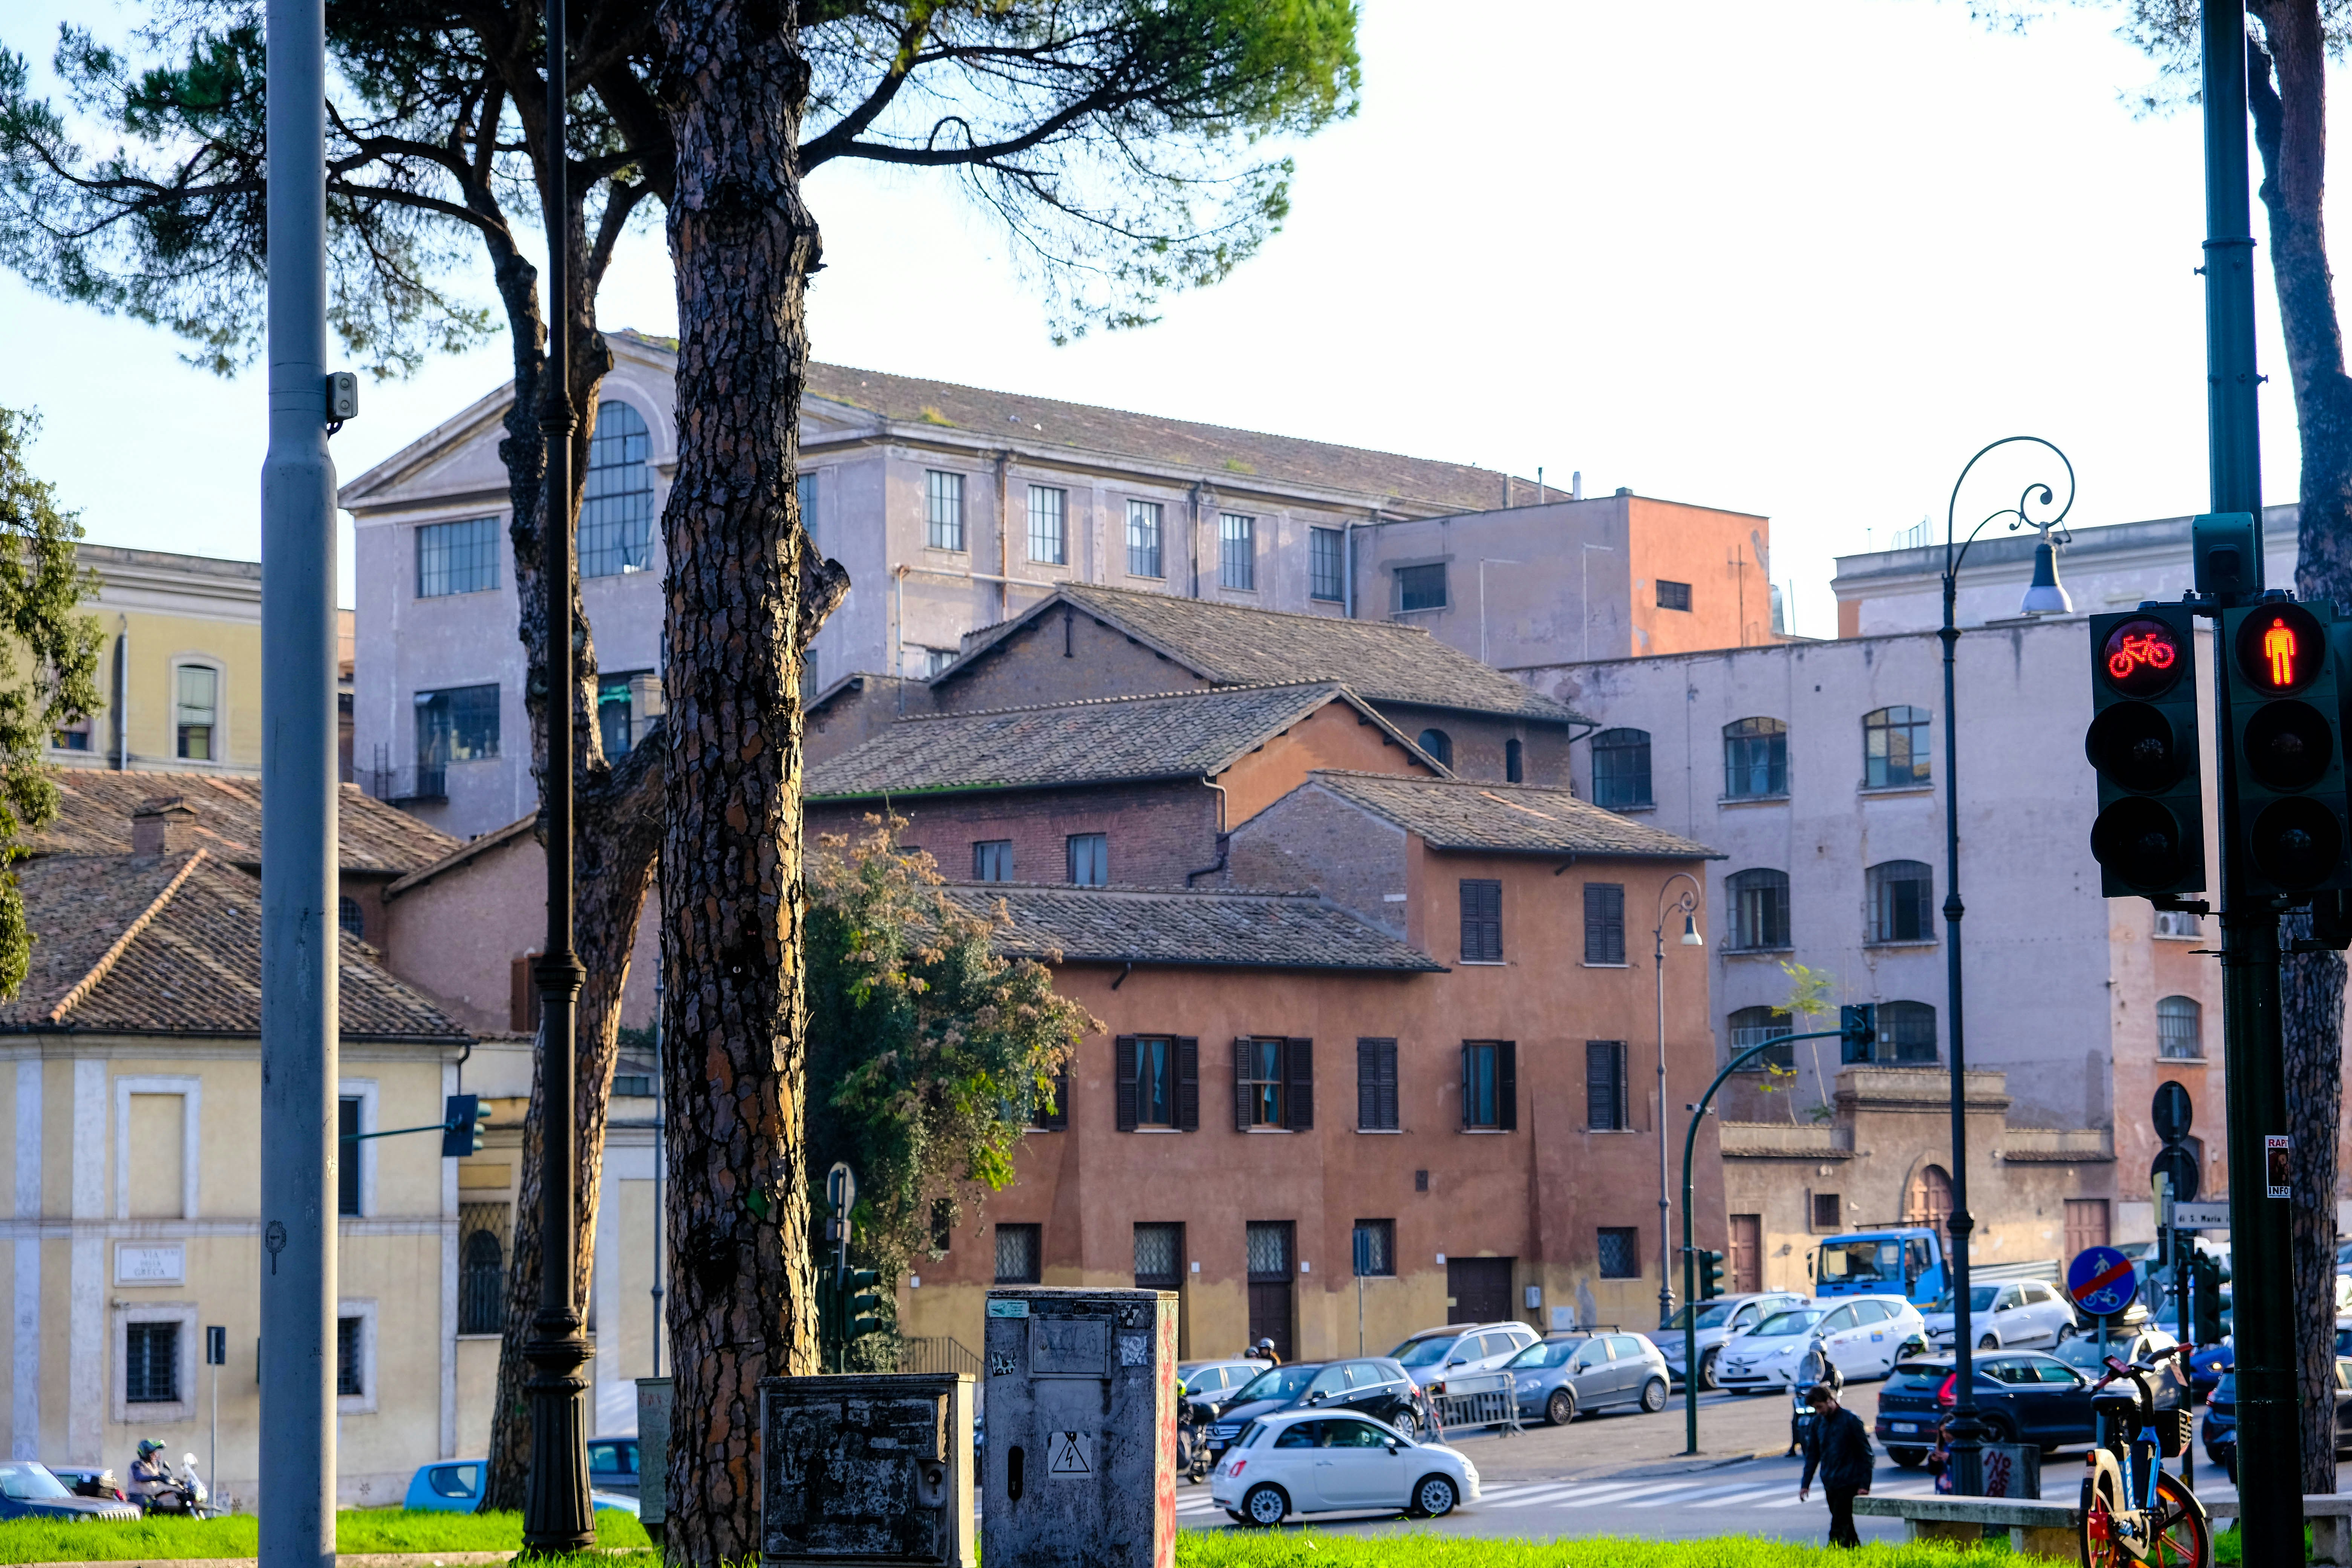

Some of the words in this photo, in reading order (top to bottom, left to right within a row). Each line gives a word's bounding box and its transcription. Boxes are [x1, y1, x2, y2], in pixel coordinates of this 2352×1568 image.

[2178, 1214, 2185, 1223] di
[2190, 1214, 2197, 1223] S.
[2201, 1214, 2221, 1223] Maria
[142, 1250, 159, 1259] VIA
